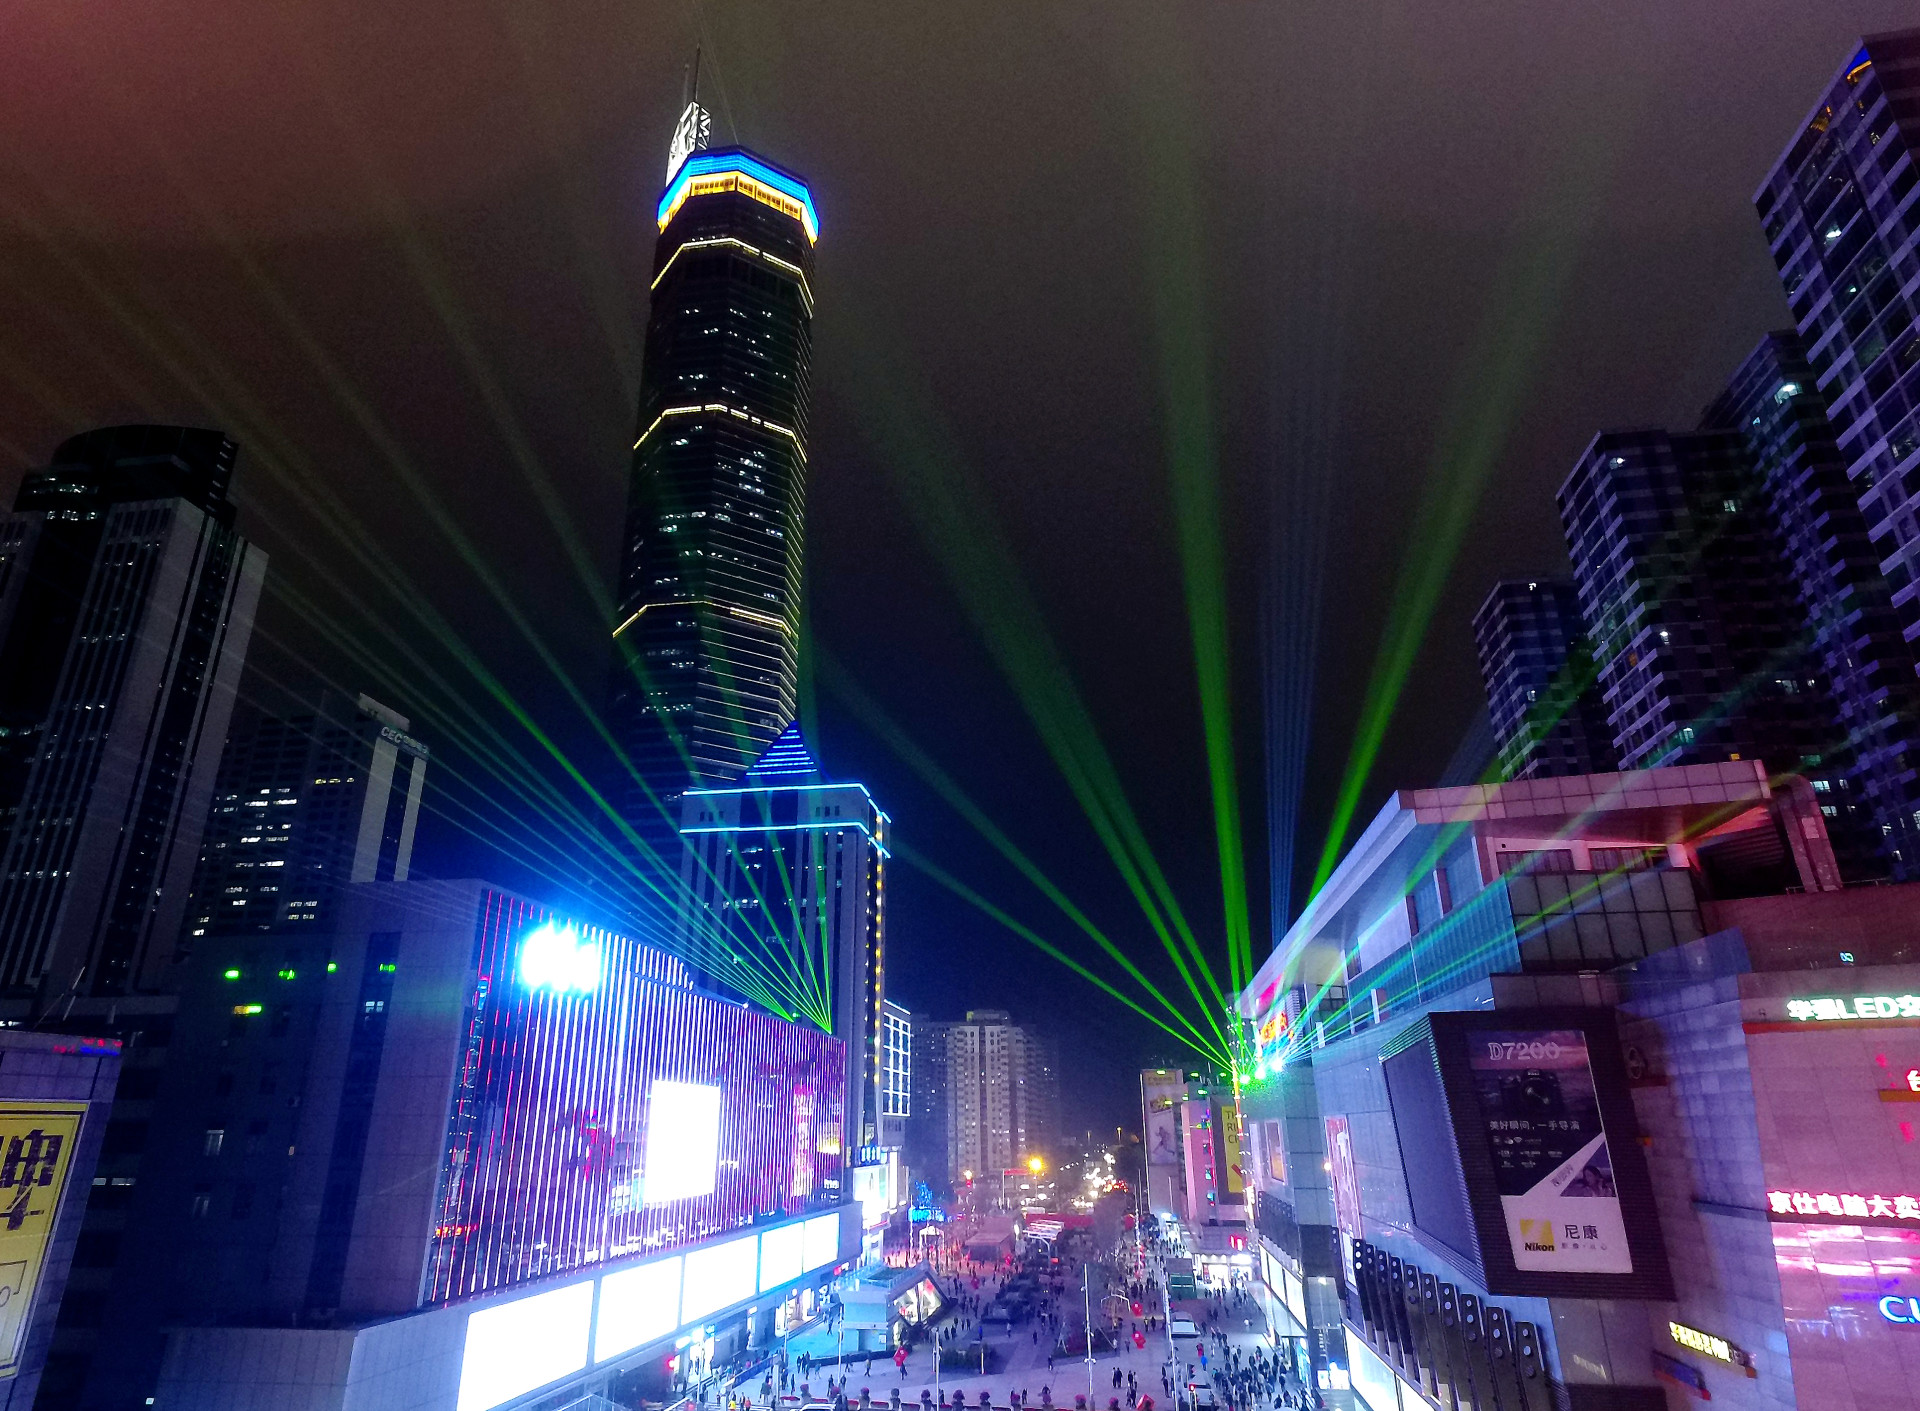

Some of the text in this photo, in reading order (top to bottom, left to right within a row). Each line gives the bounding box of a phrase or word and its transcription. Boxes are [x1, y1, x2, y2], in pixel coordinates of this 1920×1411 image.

[380, 726, 402, 744] CEC
[1488, 1042, 1560, 1060] D7200
[1564, 1225, 1598, 1239] 尼康
[1524, 1242, 1554, 1252] Nikon
